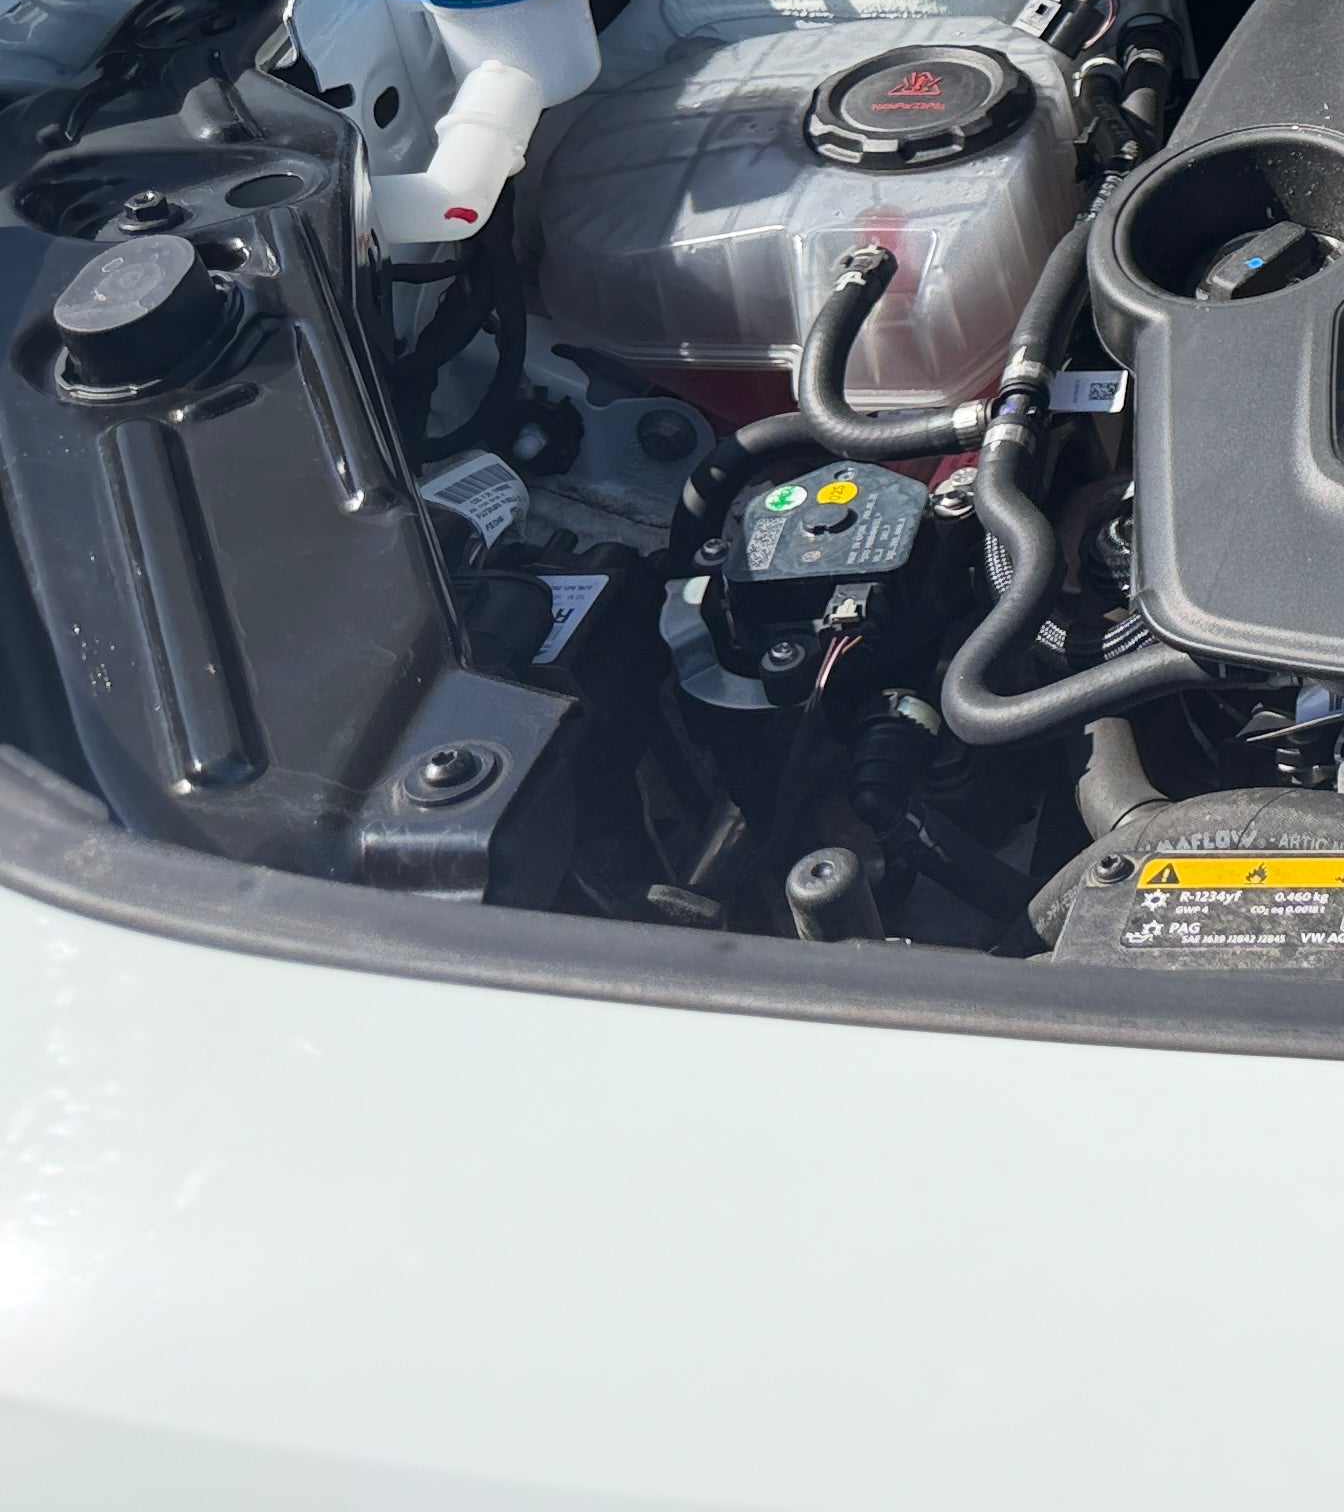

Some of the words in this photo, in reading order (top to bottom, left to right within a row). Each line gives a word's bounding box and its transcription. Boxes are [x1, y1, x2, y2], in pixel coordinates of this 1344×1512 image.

[1179, 890, 1244, 905] R-1234yf
[1313, 891, 1330, 904] kg
[1175, 906, 1200, 914] GWP
[1169, 922, 1201, 934] PAG
[1300, 933, 1326, 944] VW
